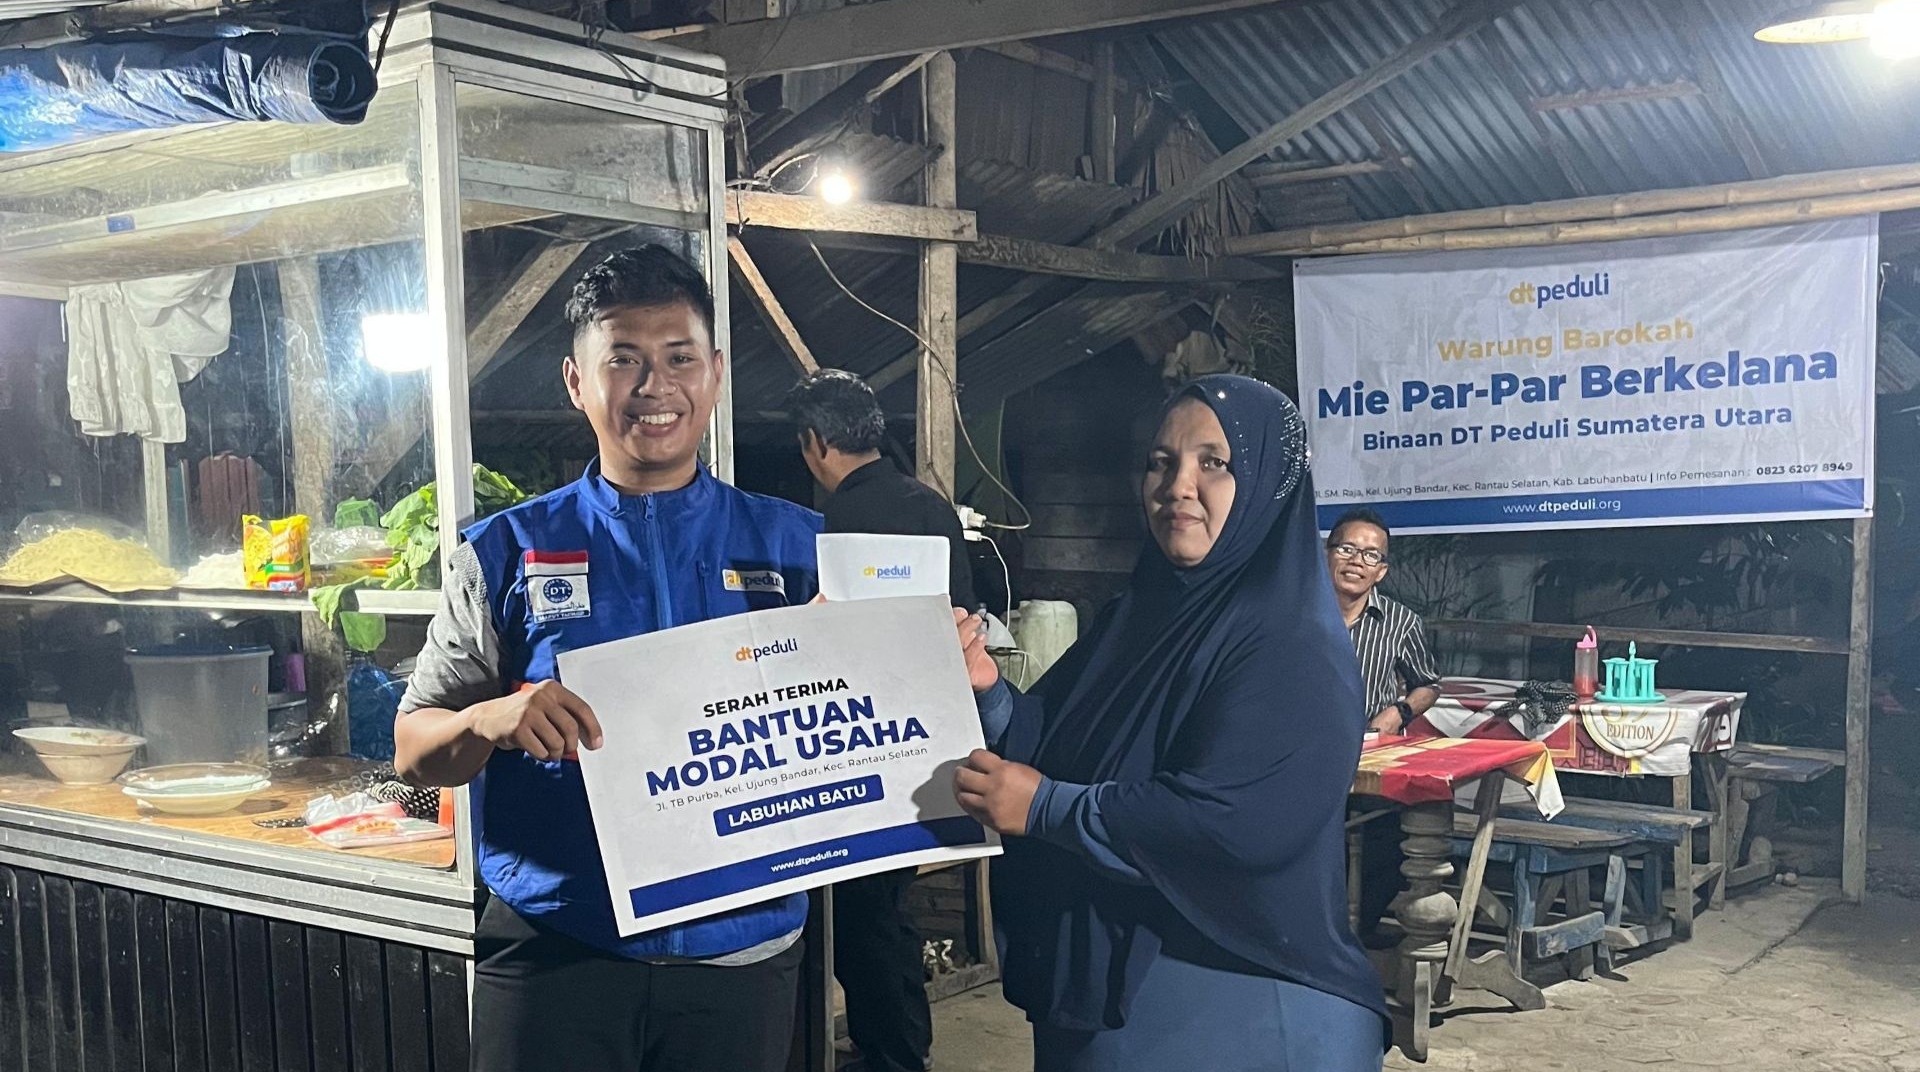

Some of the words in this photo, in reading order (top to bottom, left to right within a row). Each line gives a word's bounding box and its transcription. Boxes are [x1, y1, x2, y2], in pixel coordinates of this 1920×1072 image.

[1508, 273, 1610, 309] dtpeduli
[1437, 332, 1553, 362] Warung
[1562, 316, 1694, 350] Barokah
[1318, 380, 1390, 419] Mie
[1402, 372, 1567, 412] Par-Par
[1580, 350, 1838, 399] Berkelana
[1363, 430, 1443, 451] Binaan
[1451, 425, 1484, 445] DT
[1491, 417, 1569, 443] Peduli
[1577, 412, 1705, 437] Sumatera
[1715, 406, 1793, 428] Utara
[1342, 488, 1363, 499] Raja,
[1383, 486, 1412, 497] Ujung
[1414, 484, 1450, 494] Bandar,
[1453, 482, 1473, 492] Kec.
[1474, 480, 1510, 491] Rantau
[1511, 478, 1551, 489] Selatan,
[1577, 473, 1648, 486] Labuhanbatu
[1656, 471, 1678, 482] Info
[1680, 468, 1745, 481] Pemesanan
[1756, 464, 1786, 477] 0823
[1788, 463, 1819, 475] 6207
[1821, 461, 1854, 473] 8949
[1502, 498, 1622, 514] www.dtpeduli.org
[550, 586, 567, 596] DT
[863, 564, 912, 580] dtpeduli
[735, 637, 798, 662] dtpeduli
[703, 691, 769, 719] SERAH
[773, 677, 849, 702] TERIMA
[687, 695, 875, 756] BANTUAN
[1607, 724, 1654, 740] EDITION
[645, 743, 788, 797] MODAL
[794, 716, 930, 761] USAHA
[656, 802, 669, 812] Jl.
[670, 798, 685, 808] TB
[687, 791, 723, 804] Purba,
[724, 784, 744, 795] Kel.
[745, 777, 778, 791] Ujung
[780, 767, 822, 782] Bandar,
[823, 762, 845, 773] Kec.
[847, 754, 887, 767] Rantau
[888, 746, 928, 760] Selatan
[728, 794, 815, 828] LABUHAN
[818, 783, 868, 805] BATU
[770, 848, 849, 873] www.dtpeduli.org
